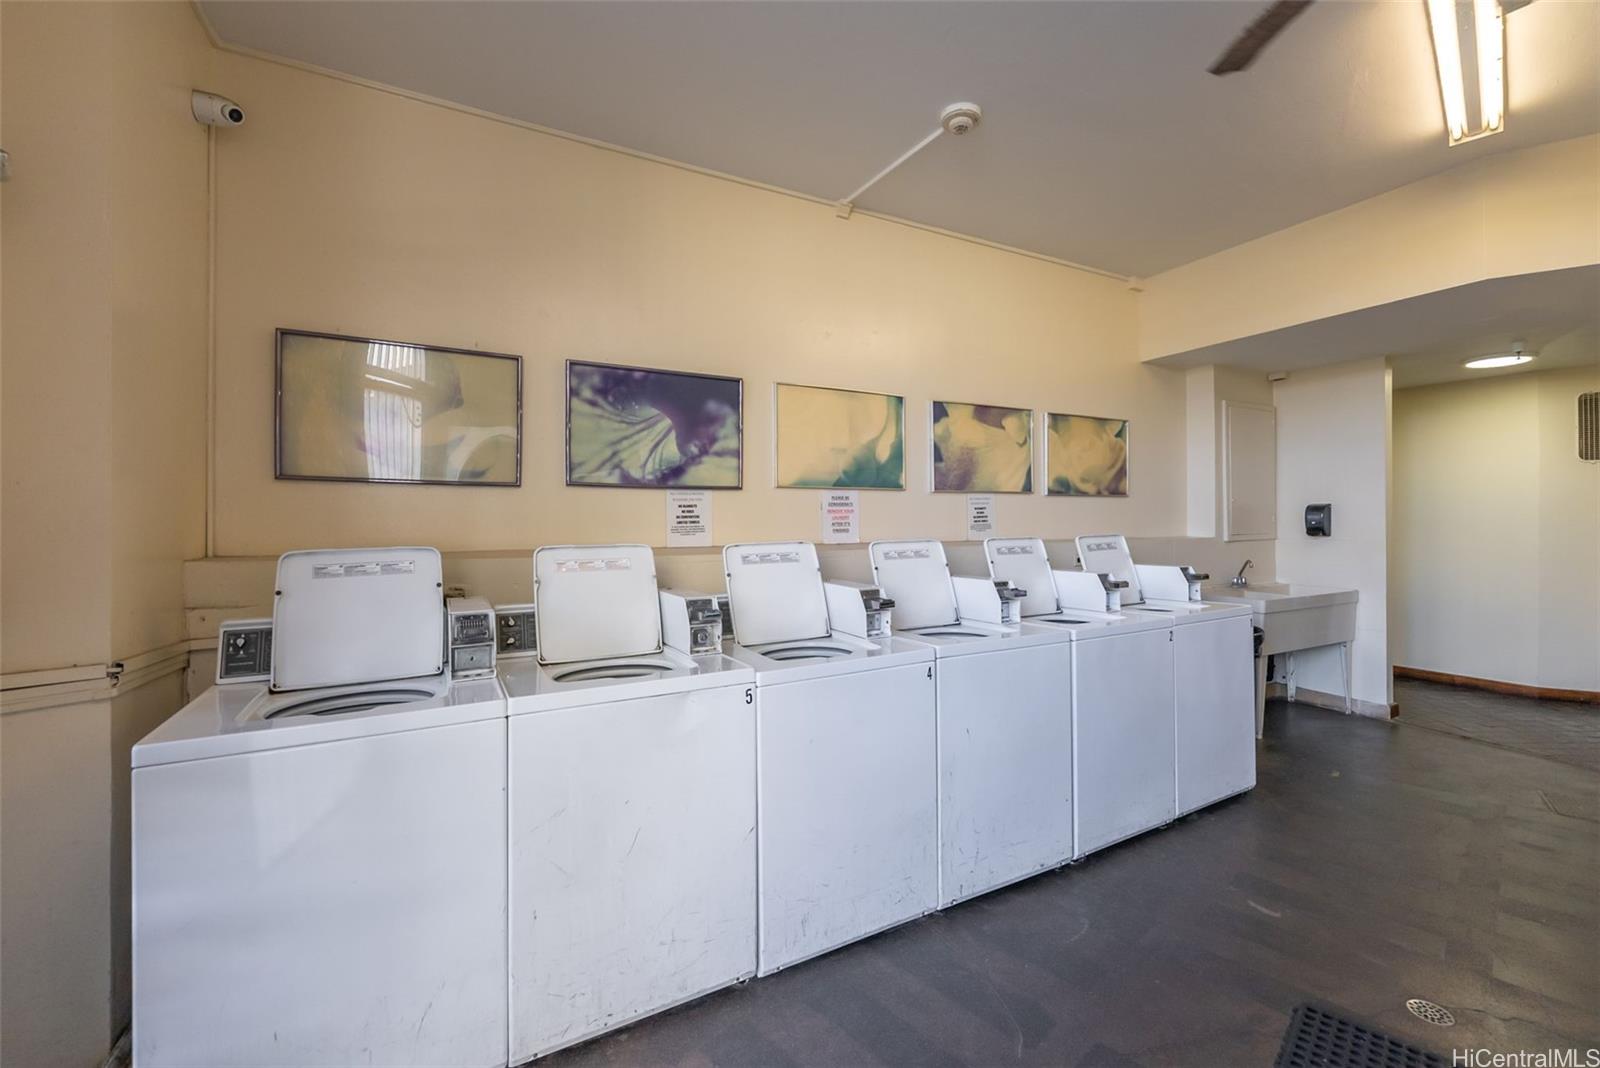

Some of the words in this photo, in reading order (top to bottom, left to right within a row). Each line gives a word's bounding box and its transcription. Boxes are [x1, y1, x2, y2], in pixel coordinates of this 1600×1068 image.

[1169, 630, 1174, 642] 2
[927, 666, 932, 681] 4
[745, 688, 753, 704] 5
